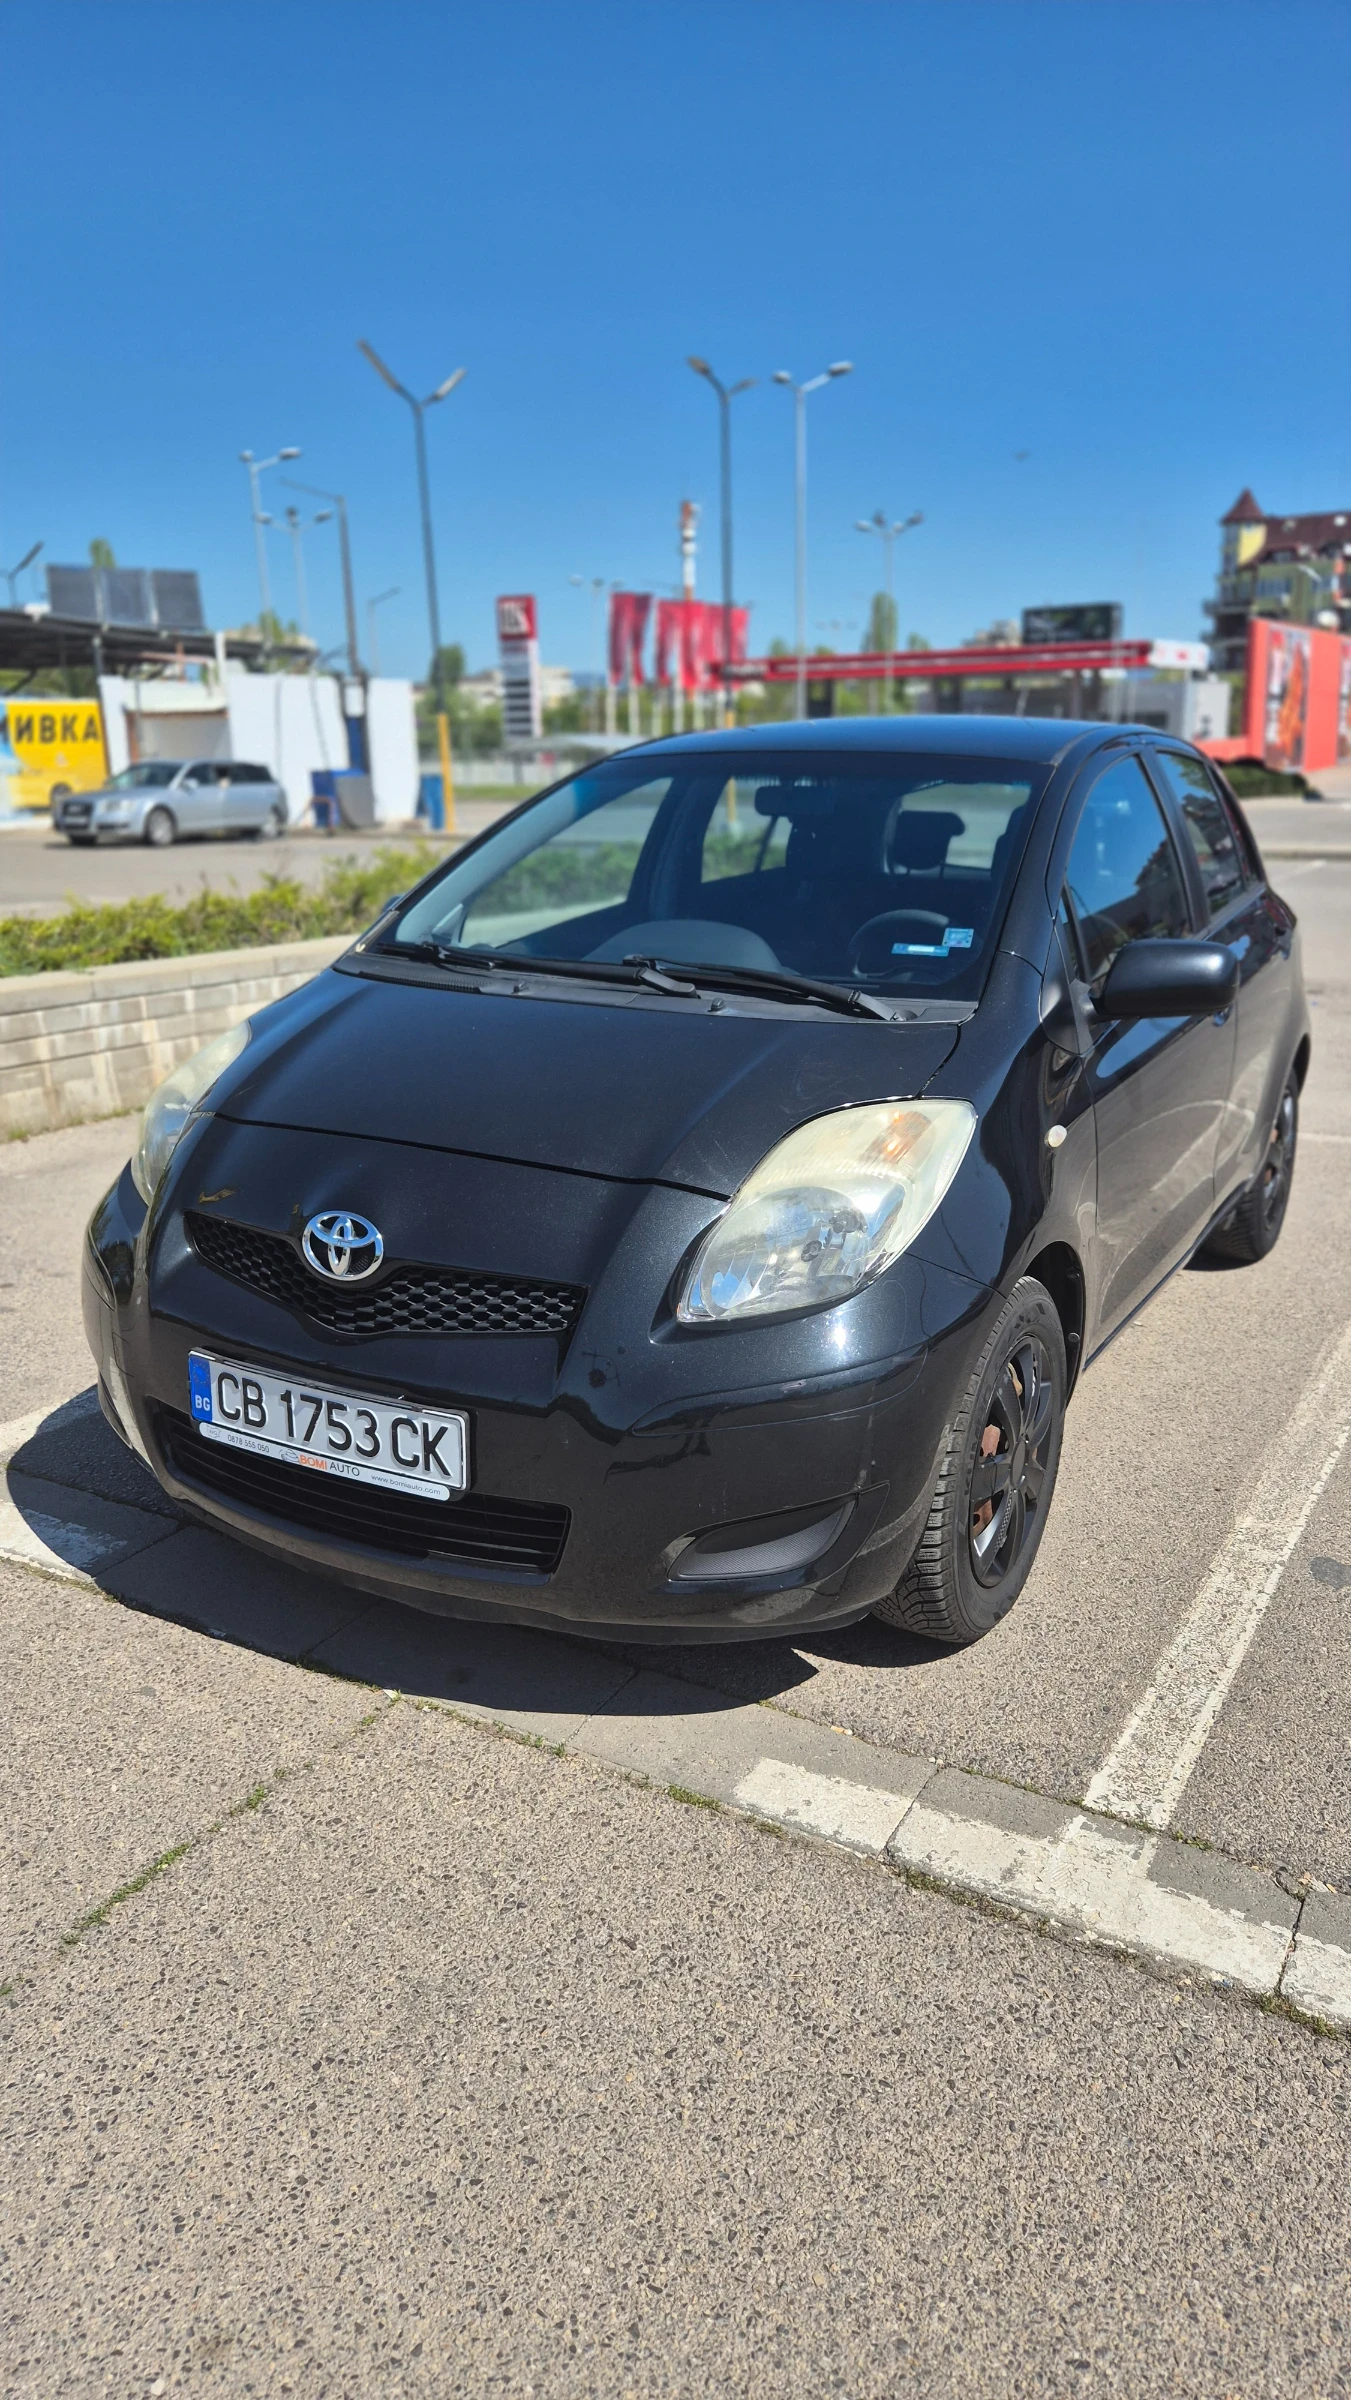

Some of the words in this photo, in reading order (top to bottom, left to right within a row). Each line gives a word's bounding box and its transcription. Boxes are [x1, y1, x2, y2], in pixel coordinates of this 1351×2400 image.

[195, 1394, 211, 1412] BG
[217, 1371, 267, 1428] CB
[280, 1389, 381, 1458] 1753
[391, 1416, 452, 1477] CK
[227, 1434, 243, 1446] 0878
[244, 1439, 256, 1450] 555
[257, 1443, 270, 1453] 050
[299, 1454, 328, 1470] BOMI
[329, 1461, 361, 1477] AUTO
[370, 1475, 441, 1495] www.bomiauto.com
